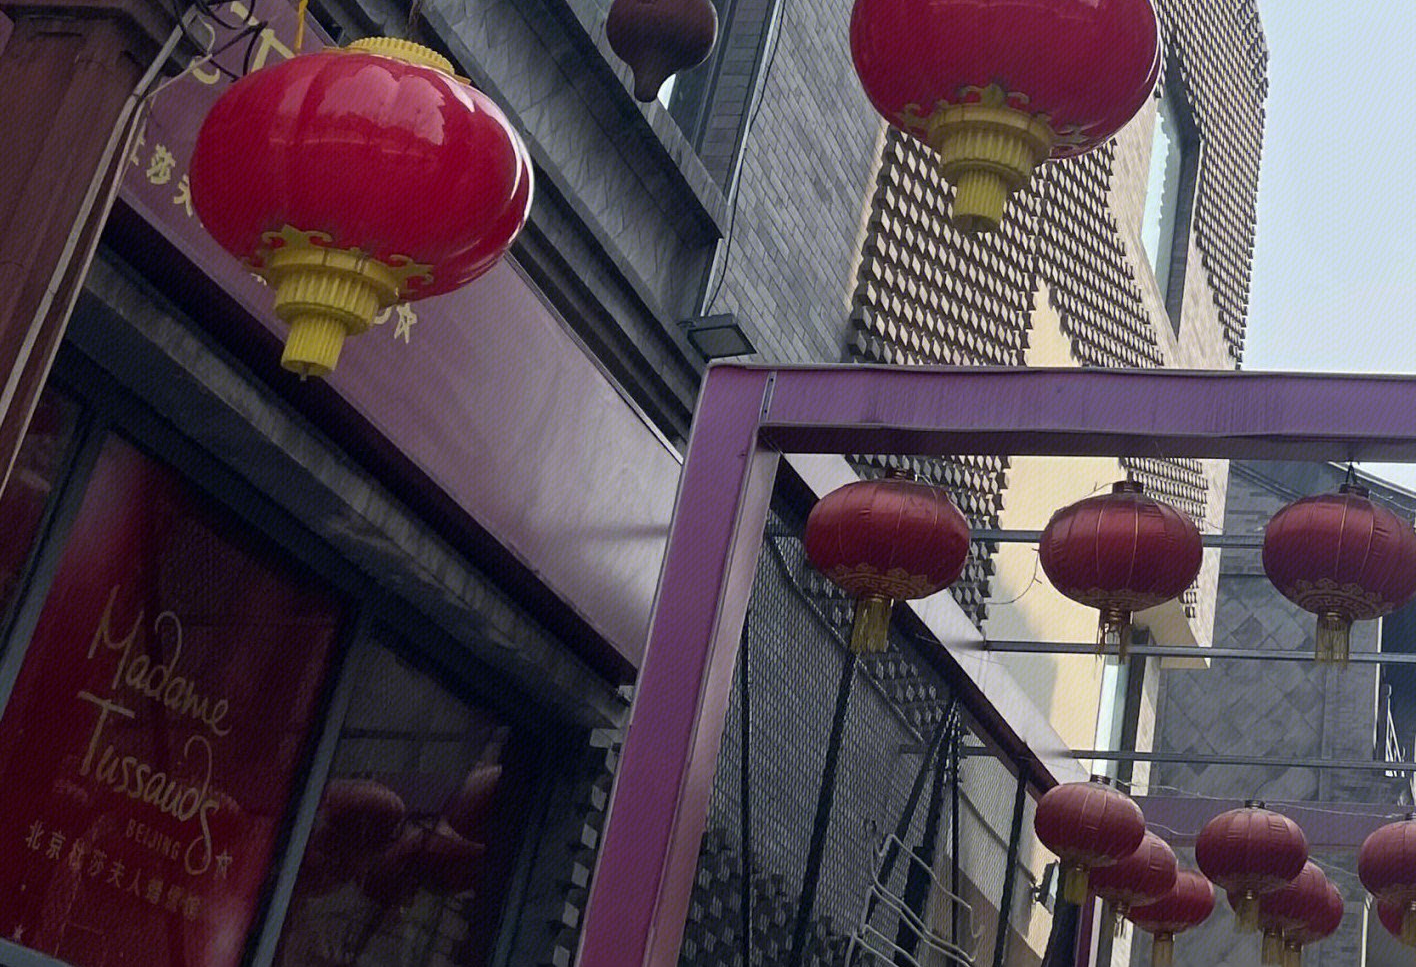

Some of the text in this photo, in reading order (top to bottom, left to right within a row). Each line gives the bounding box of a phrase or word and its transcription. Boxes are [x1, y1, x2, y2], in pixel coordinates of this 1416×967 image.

[87, 584, 233, 736] Madame
[76, 689, 220, 876] Tussauds
[125, 817, 181, 860] BEIJING
